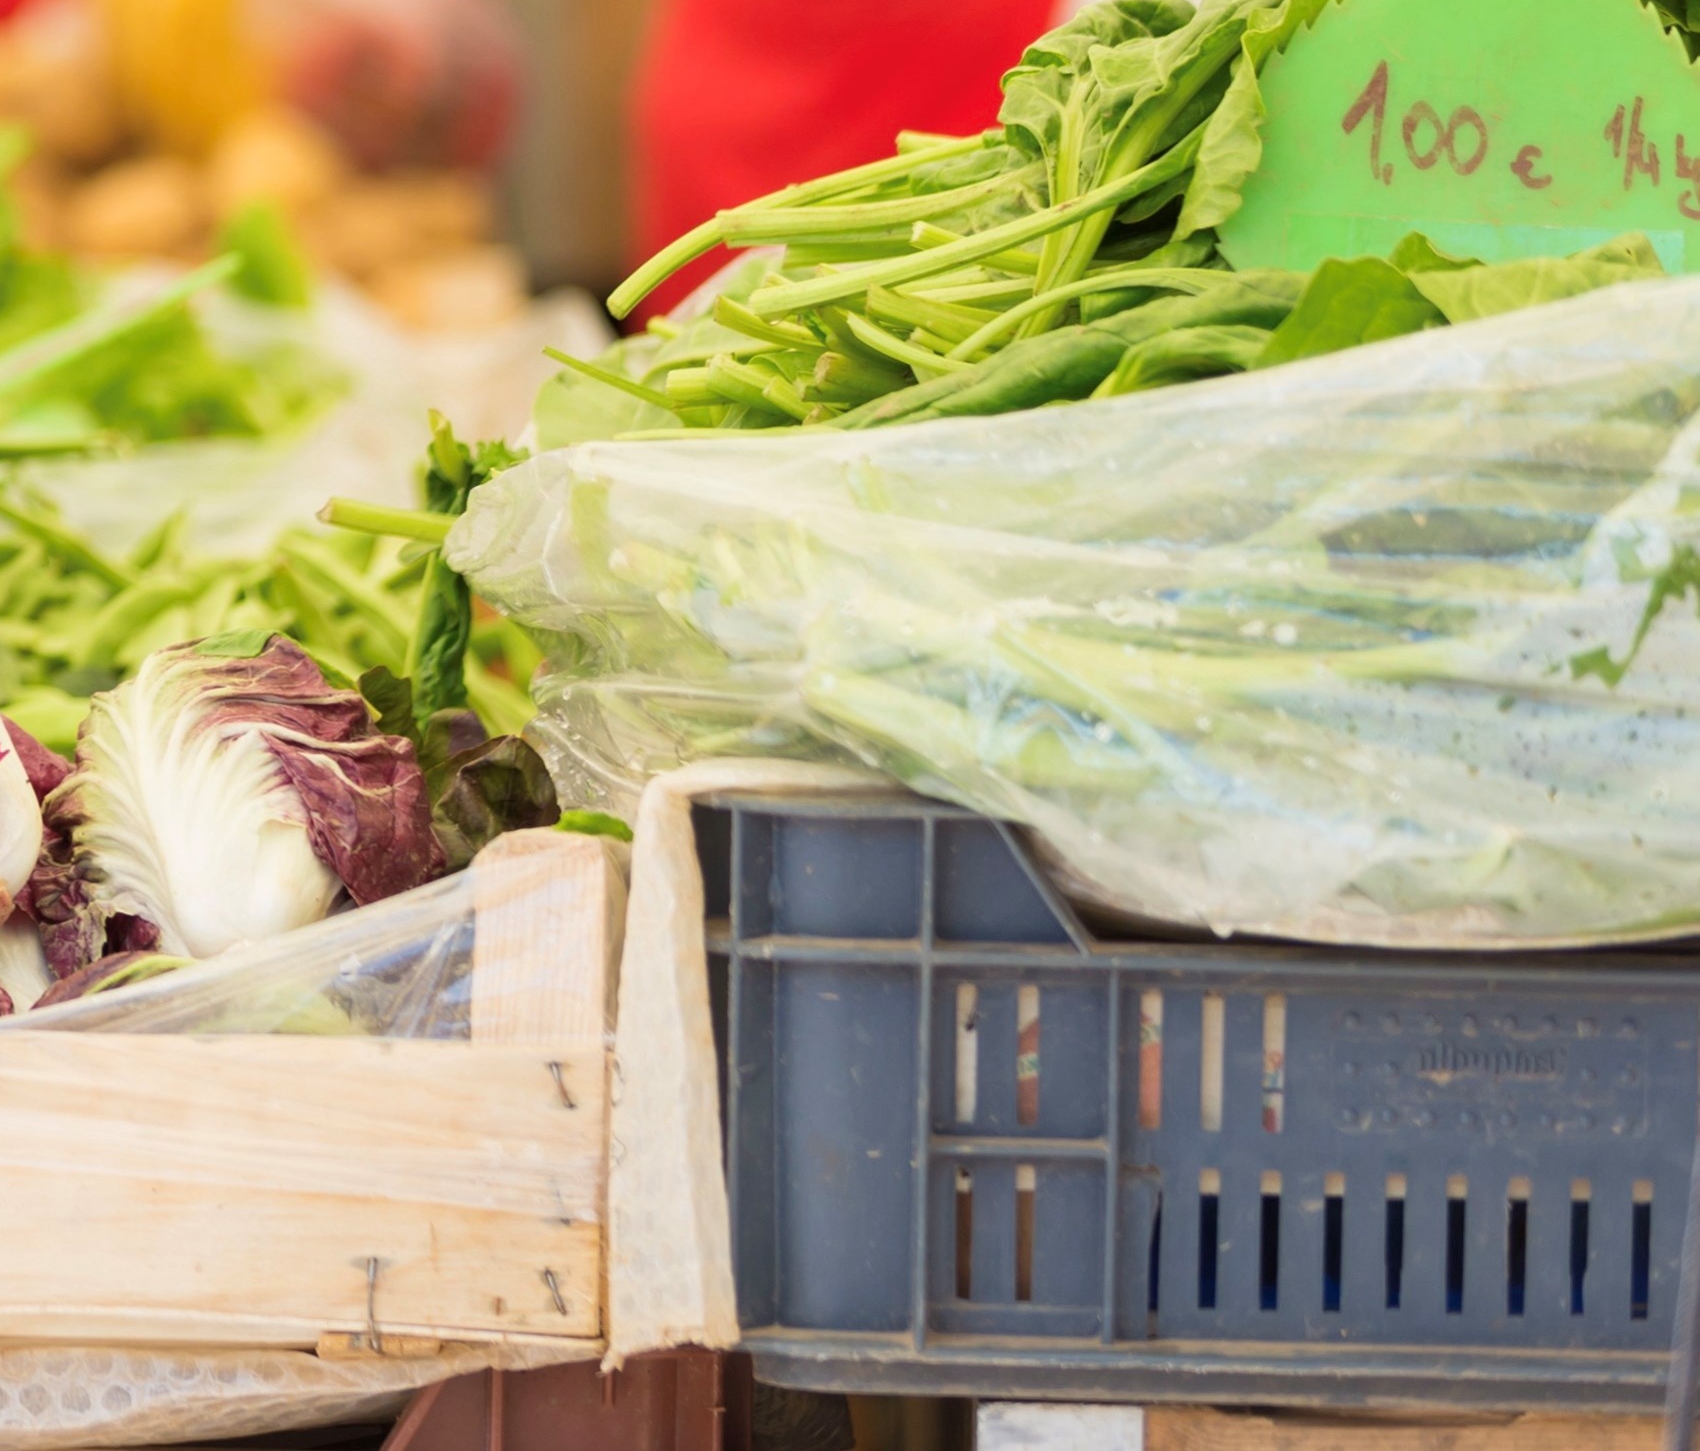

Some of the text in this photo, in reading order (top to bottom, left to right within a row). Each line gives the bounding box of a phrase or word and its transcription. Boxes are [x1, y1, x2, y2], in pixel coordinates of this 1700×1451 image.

[1341, 60, 1489, 186] 1,00
[1510, 145, 1552, 189] €
[1603, 96, 1660, 191] 1/4
